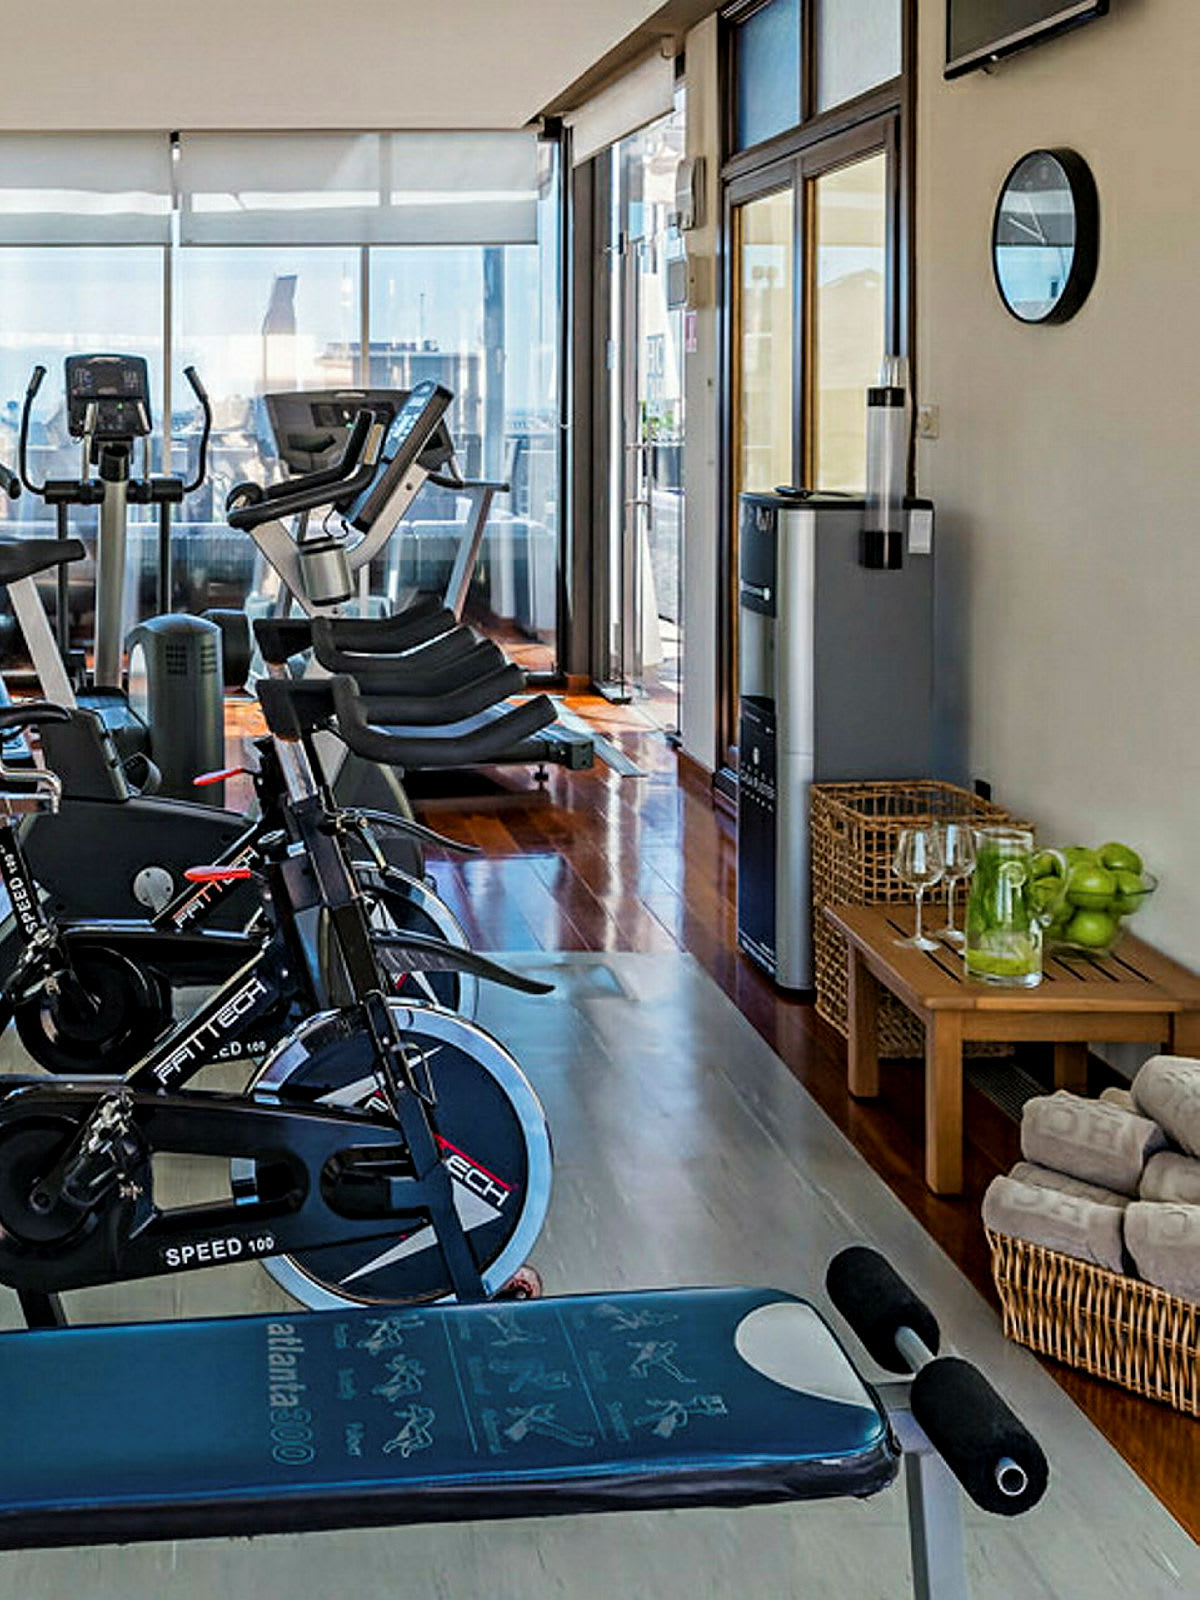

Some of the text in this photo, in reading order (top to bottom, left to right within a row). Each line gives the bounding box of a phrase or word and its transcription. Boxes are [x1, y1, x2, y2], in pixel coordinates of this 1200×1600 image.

[9, 877, 39, 935] SPEED
[165, 1236, 275, 1267] SPEED 100
